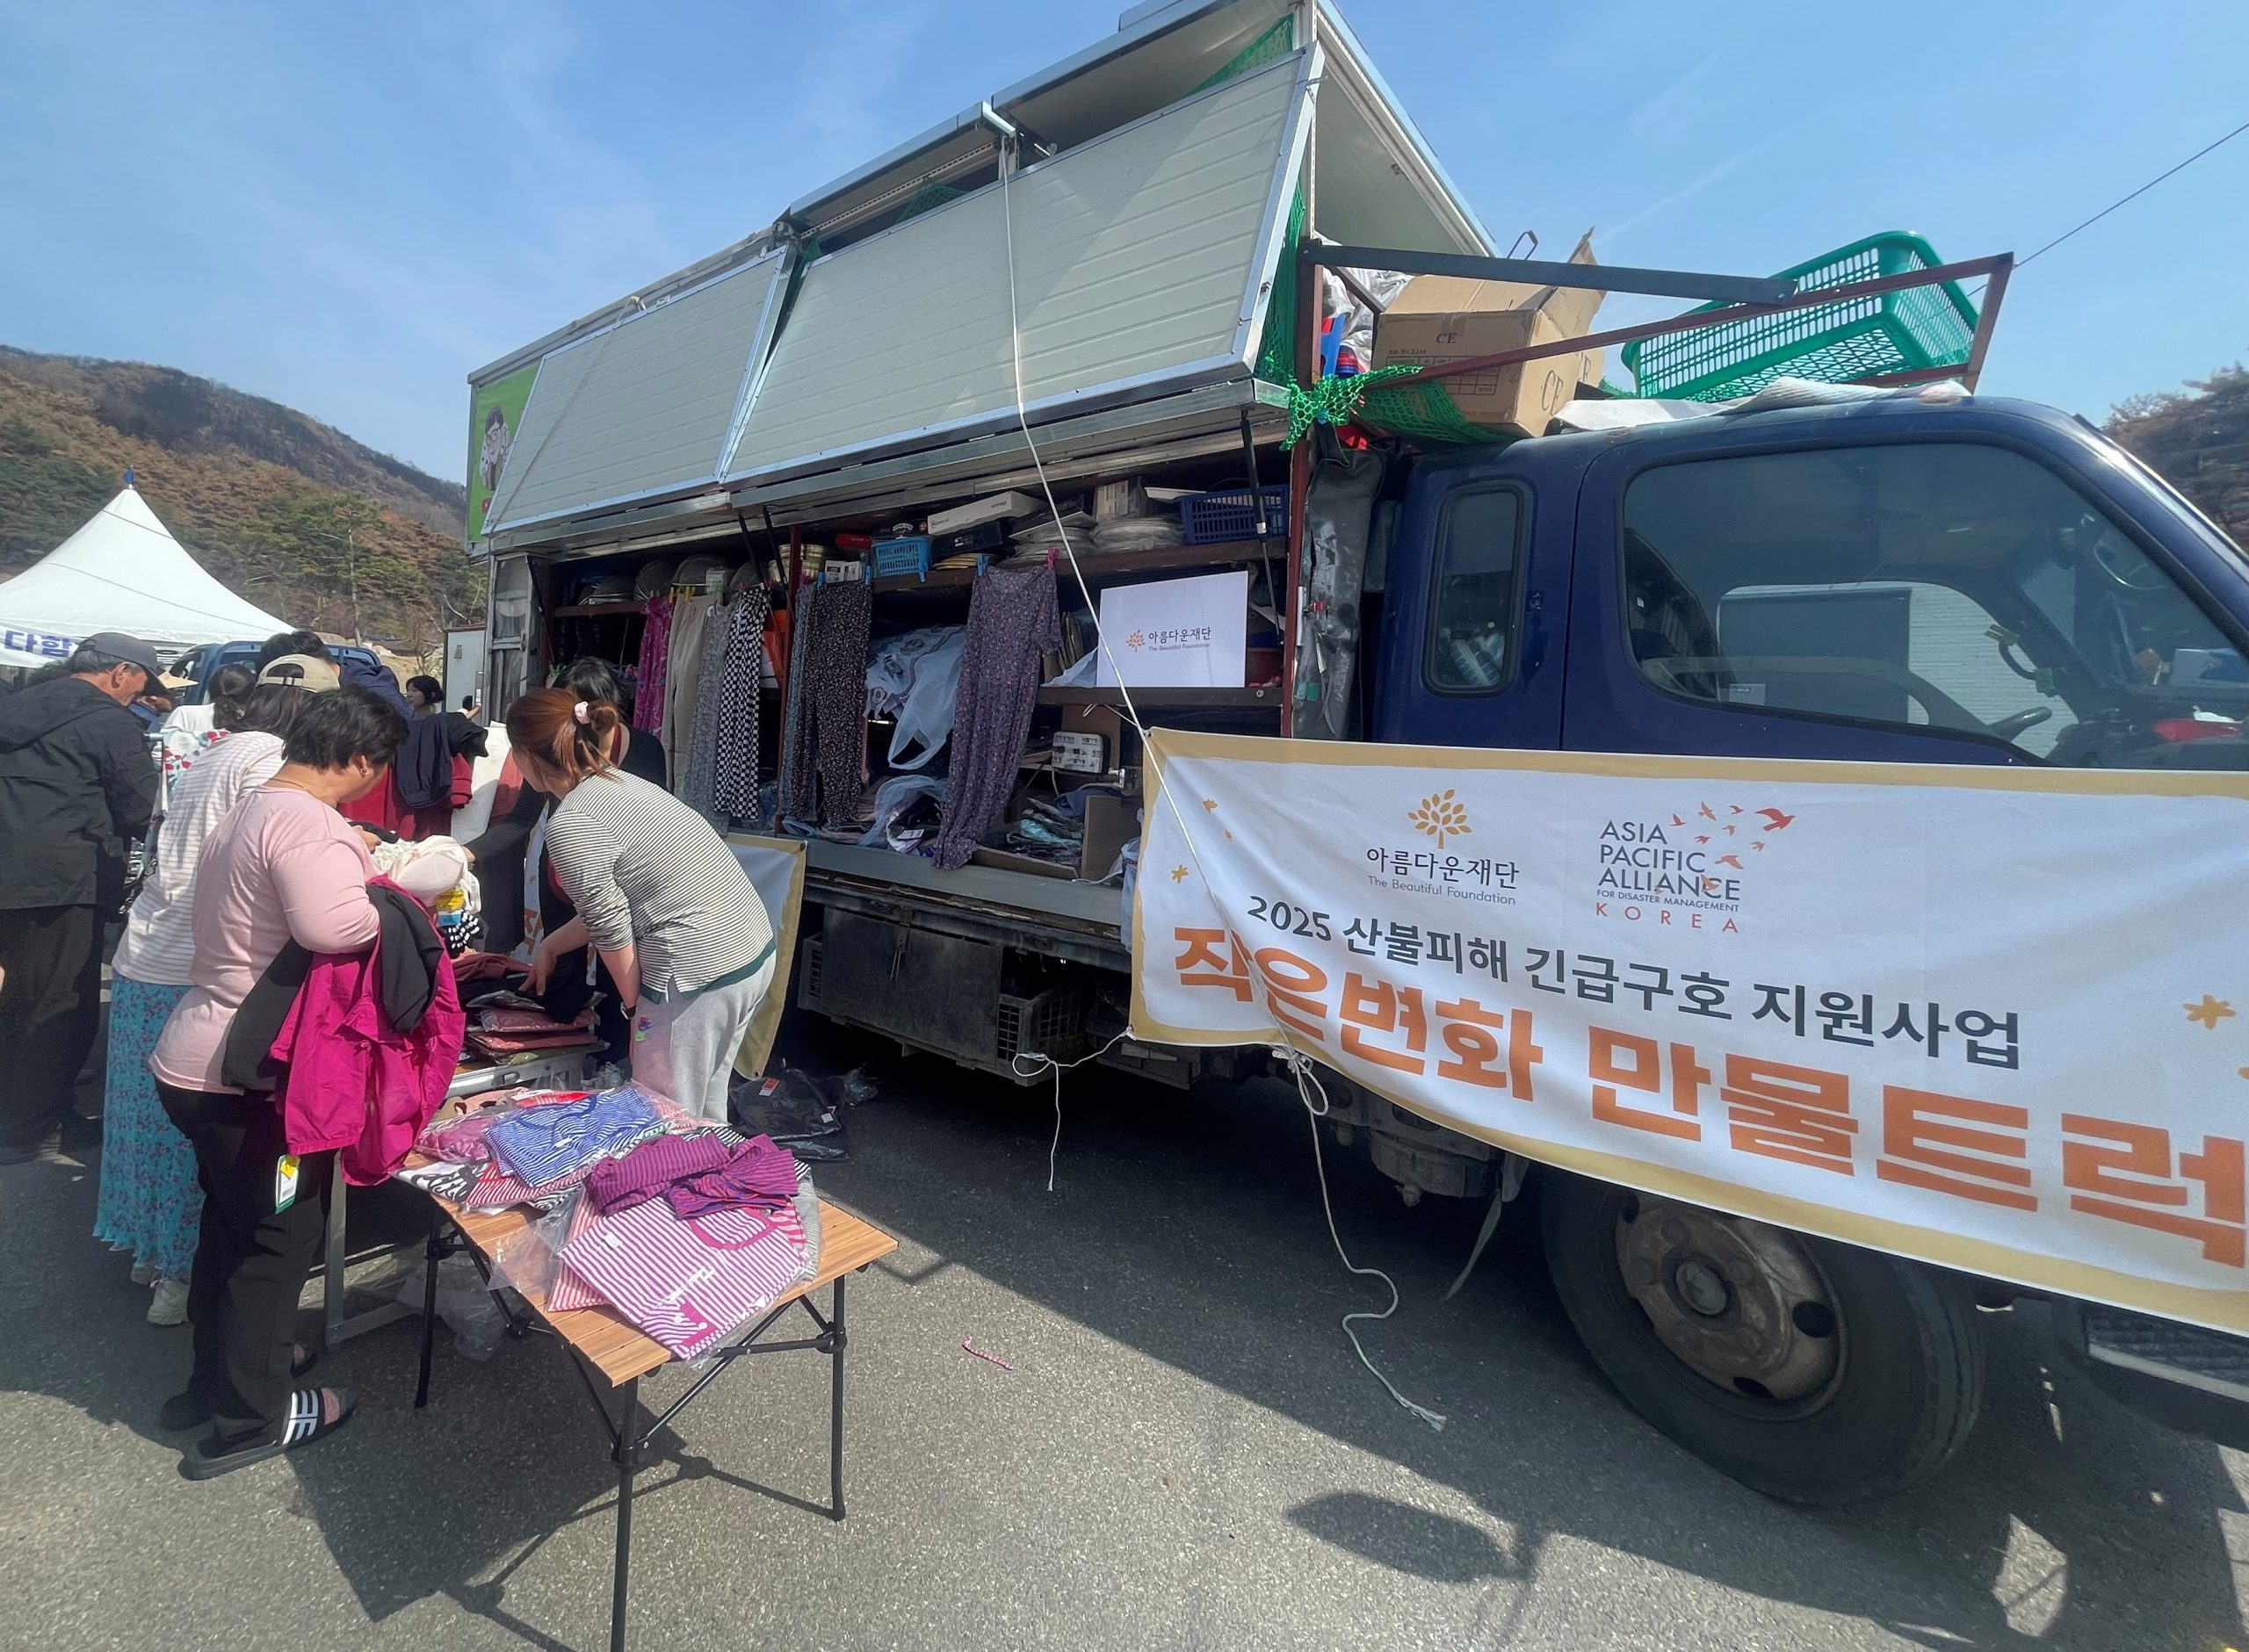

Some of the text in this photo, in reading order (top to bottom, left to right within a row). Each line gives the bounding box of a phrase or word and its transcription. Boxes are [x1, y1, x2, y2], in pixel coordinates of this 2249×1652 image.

[1435, 332, 1457, 344] CE
[1147, 626, 1212, 645] 아름다운재단
[1599, 819, 1668, 845] ASIA
[1366, 847, 1521, 890] 아름다운재단
[1600, 844, 1706, 873] PACIFIC
[1367, 875, 1516, 905] The Beautiful Foundation
[1597, 867, 1740, 901] ALLIANCE
[1596, 889, 1739, 913] FOR DISASTER MANAGEMENT
[1595, 902, 1739, 934] KOREA
[1247, 895, 2020, 1071] 2025 산불피해 긴급구호 지원사업
[1174, 927, 2246, 1269] 작은변화 만물트럭
